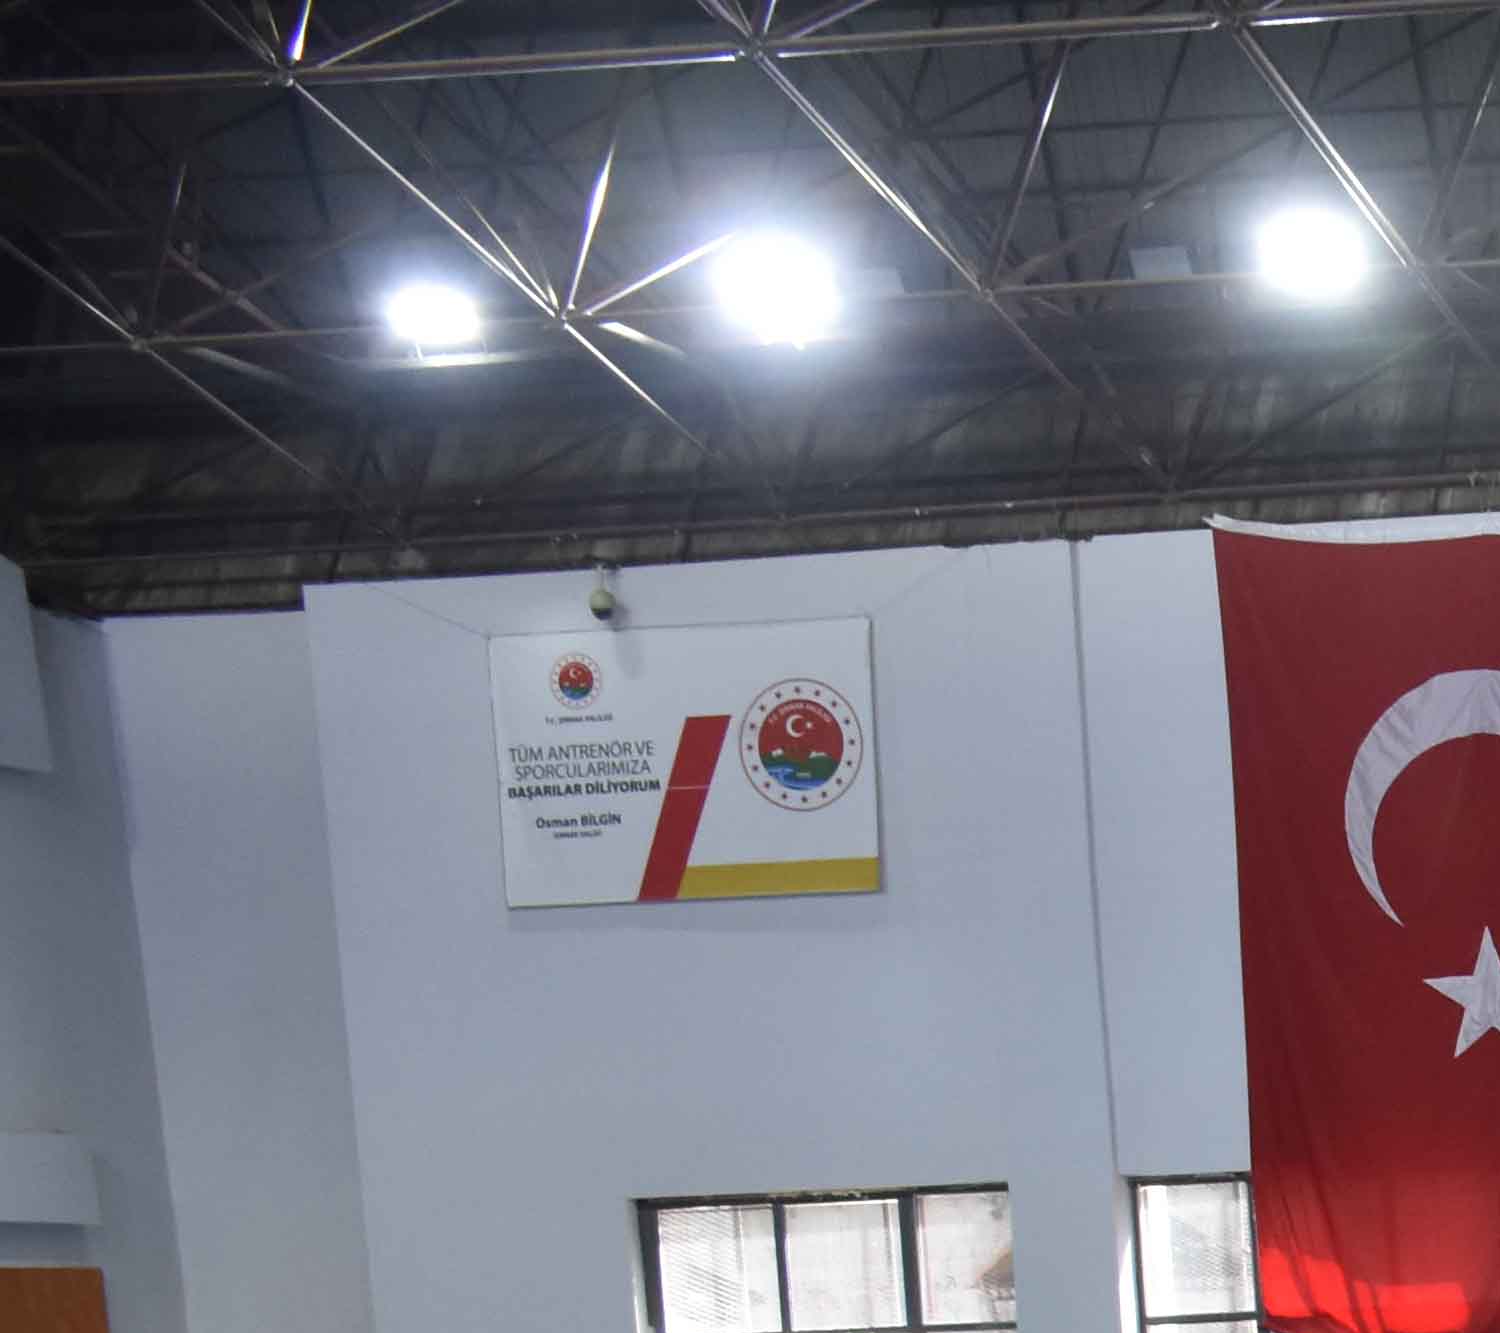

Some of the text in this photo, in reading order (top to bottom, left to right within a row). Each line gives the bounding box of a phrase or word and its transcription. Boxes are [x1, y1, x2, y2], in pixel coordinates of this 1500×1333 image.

[509, 740, 655, 763] TÜM ANTRENÖR VE
[514, 759, 651, 781] SPORCULARIMIZA
[508, 779, 661, 801] BAŞARILAR DİLİYORUM
[536, 817, 578, 829] Osman
